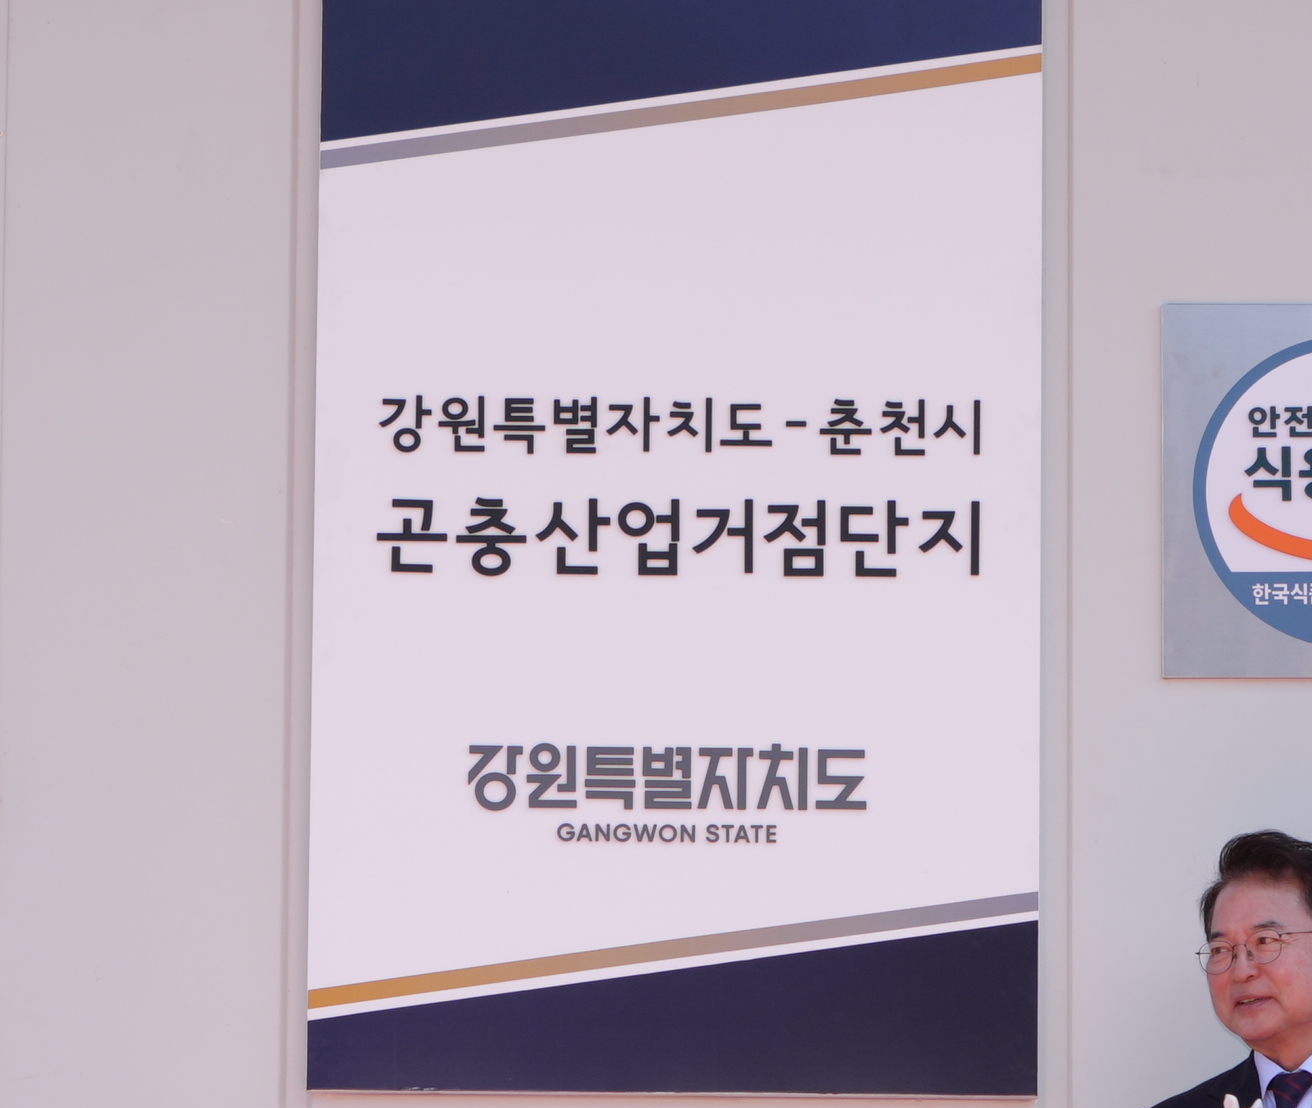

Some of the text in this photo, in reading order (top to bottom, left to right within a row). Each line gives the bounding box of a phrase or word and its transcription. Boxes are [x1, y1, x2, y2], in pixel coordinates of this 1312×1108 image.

[377, 497, 980, 577] 곤충산업거점단지
[468, 743, 866, 811] 강원특별자치도
[557, 823, 777, 844] GANGWON STATE
